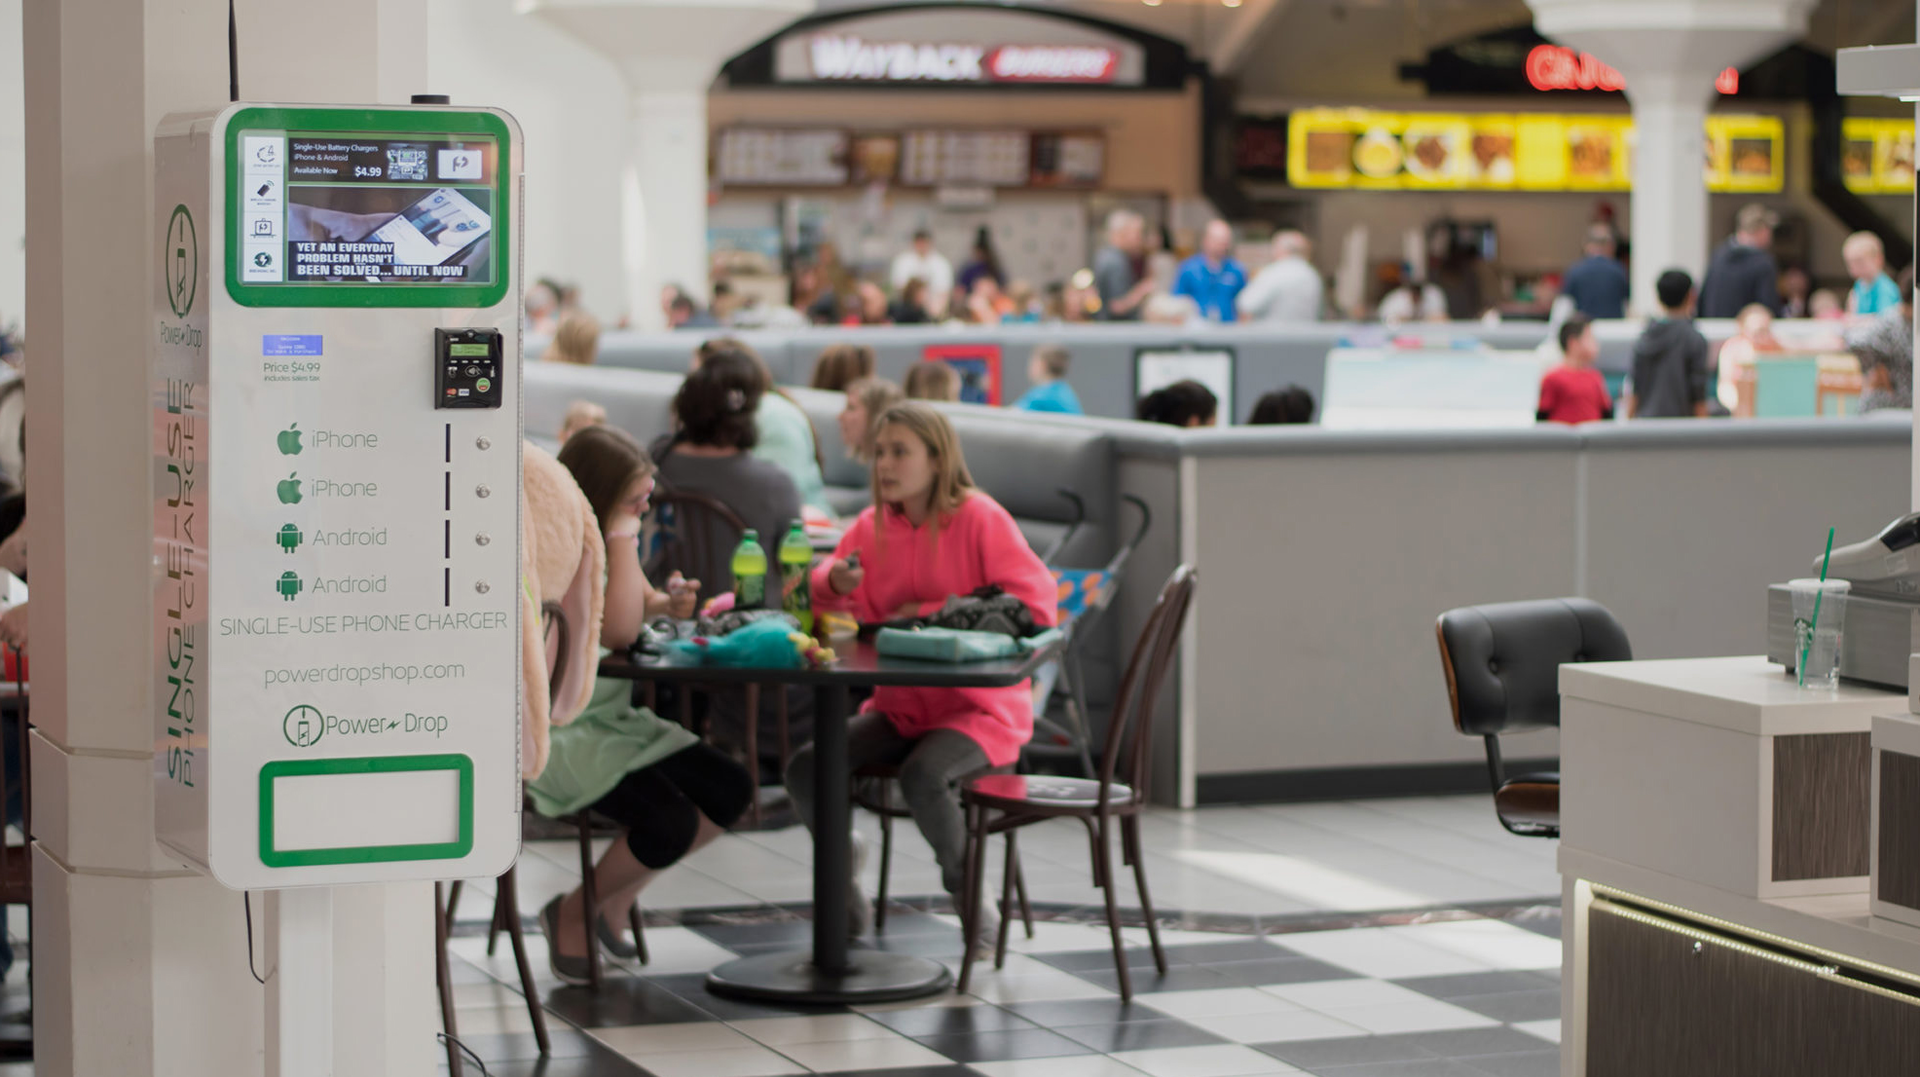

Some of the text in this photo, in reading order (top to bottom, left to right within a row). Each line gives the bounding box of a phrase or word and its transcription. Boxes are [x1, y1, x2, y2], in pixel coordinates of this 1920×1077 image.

[294, 143, 378, 153] Single-Use Battery Chargers
[355, 166, 382, 177] $4.99
[298, 243, 393, 252] YET AN EVERYDAY
[298, 254, 393, 263] PROBLEM HASN'T
[298, 265, 463, 276] BEEN SOLVED... UNTIL NOW
[263, 361, 321, 374] Price $4.99
[312, 430, 378, 448] iPhone
[311, 479, 377, 497] iPhone
[312, 527, 387, 546] Android
[167, 378, 182, 783] SINGLE-USE
[183, 382, 195, 788] PHONE CHARGER
[312, 575, 387, 593] Android
[220, 612, 508, 636] SINGLE-USE PHONE CHARGER
[264, 662, 465, 689] powerdropshop.com
[326, 713, 448, 738] Power Drop
